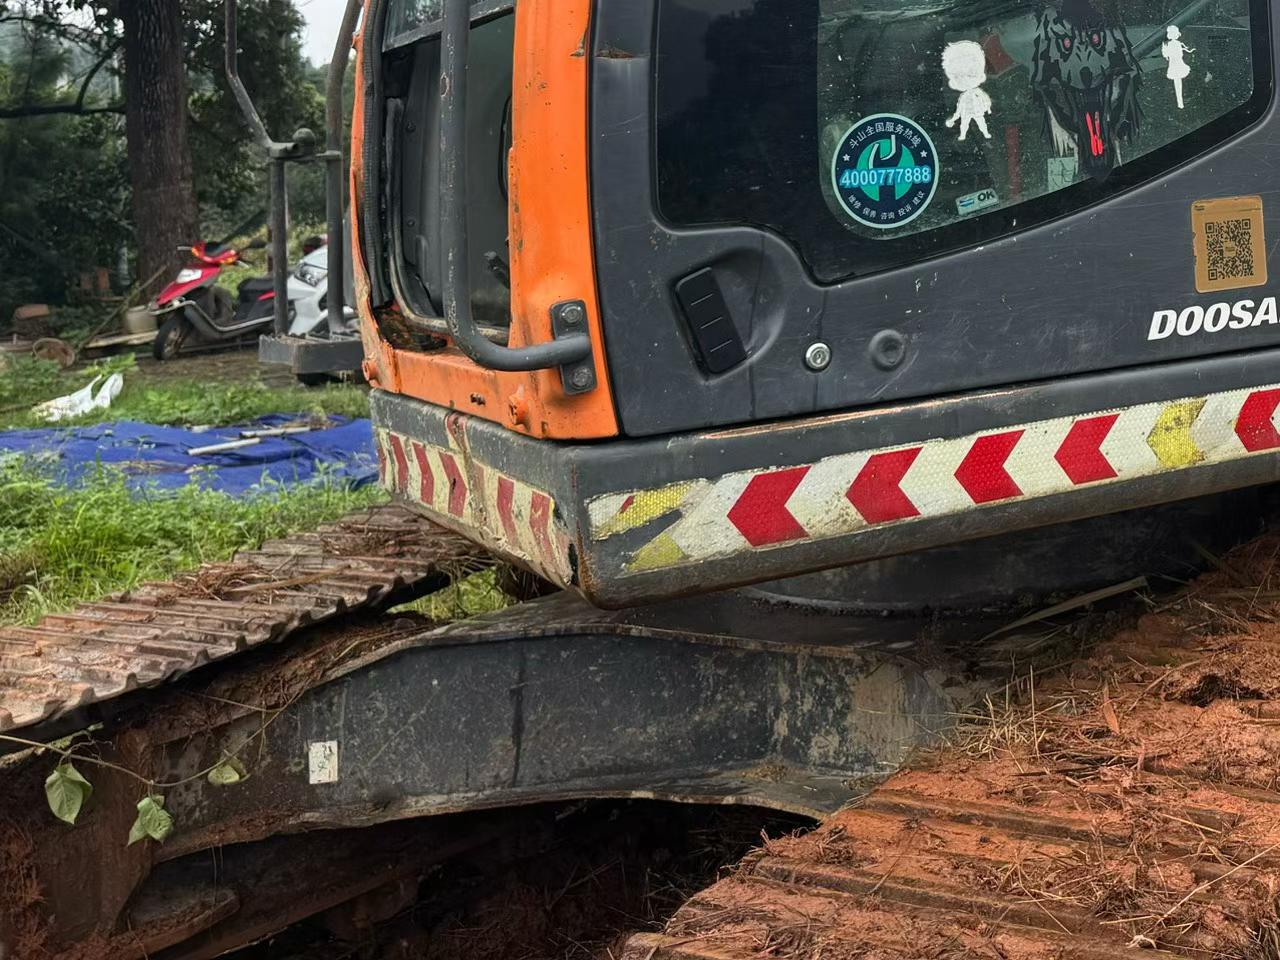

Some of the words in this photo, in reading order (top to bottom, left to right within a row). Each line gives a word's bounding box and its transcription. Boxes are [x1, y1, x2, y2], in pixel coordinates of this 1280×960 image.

[849, 122, 921, 148] 斗山全国服务热线
[841, 167, 931, 186] 4000777888
[977, 191, 995, 201] OK
